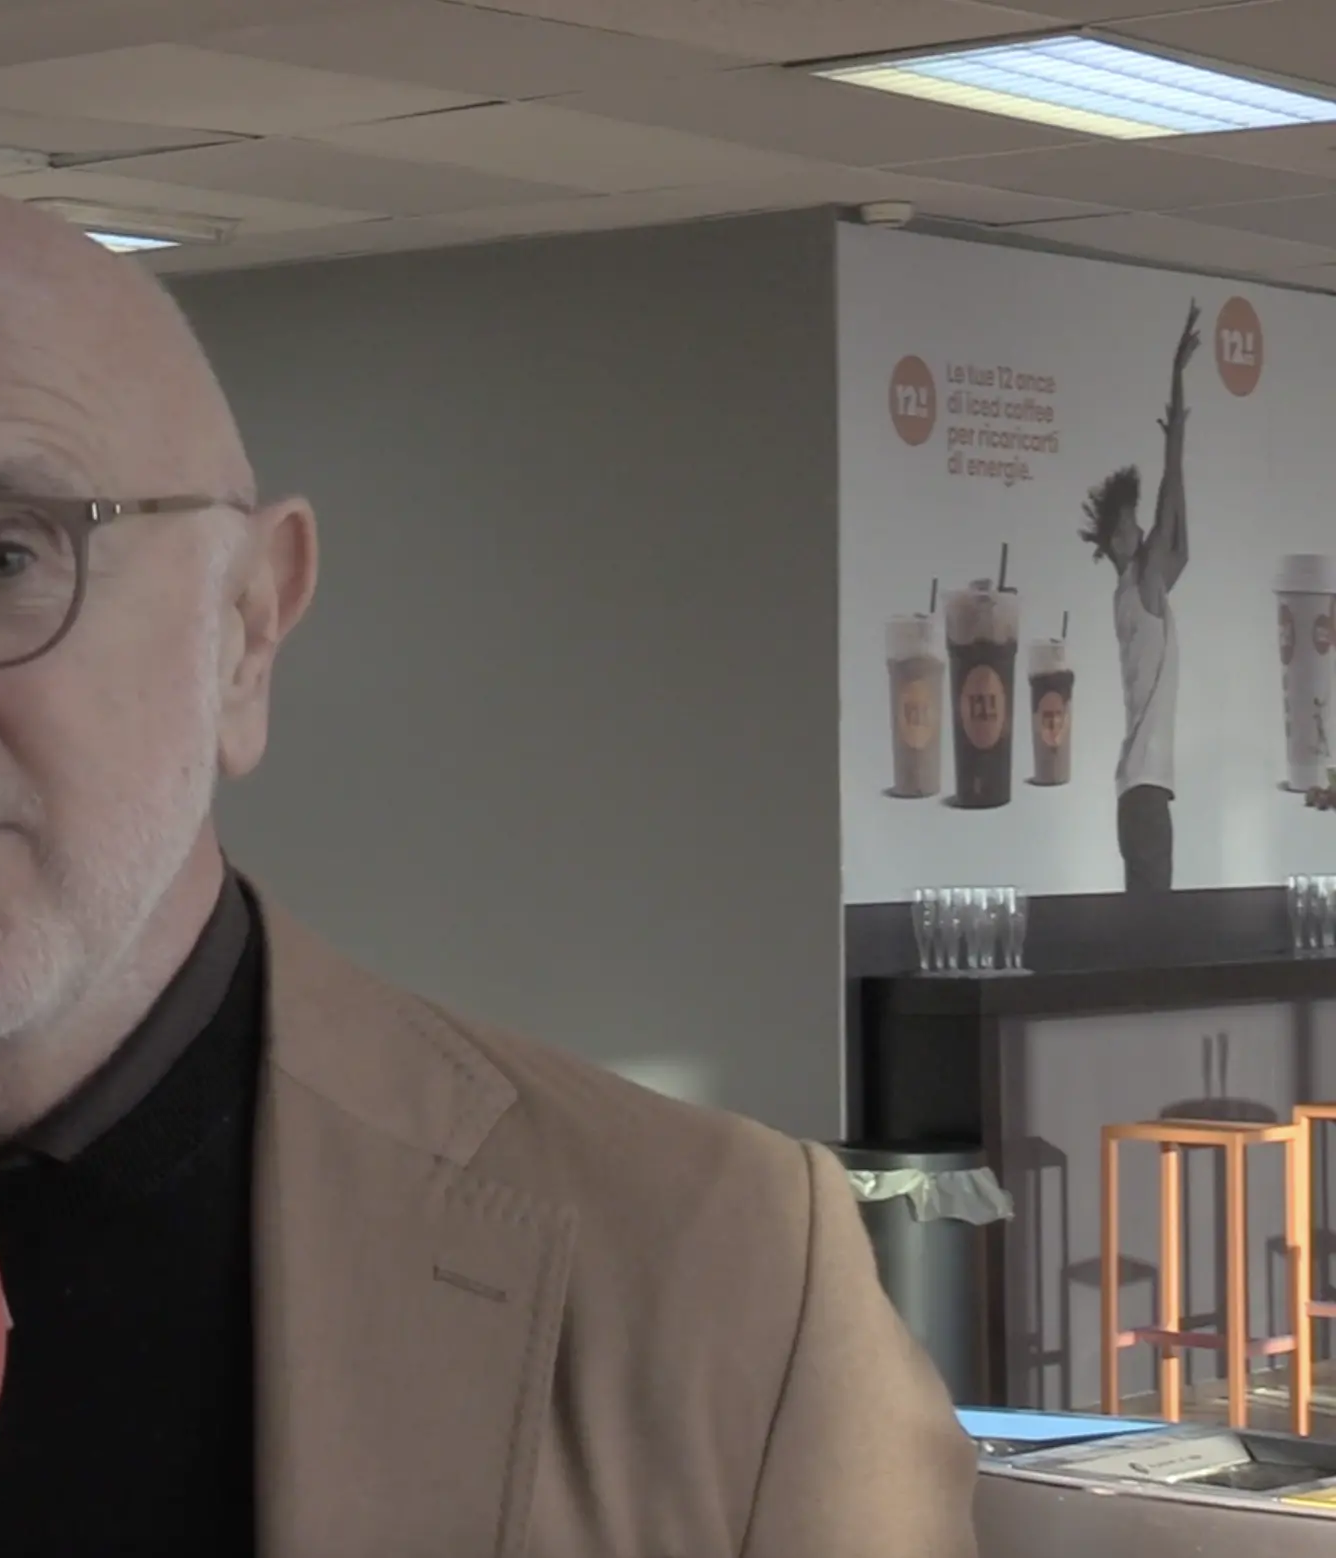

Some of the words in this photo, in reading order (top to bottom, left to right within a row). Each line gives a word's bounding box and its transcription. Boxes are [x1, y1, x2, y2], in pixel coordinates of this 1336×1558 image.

[947, 361, 965, 383] Le
[968, 365, 994, 386] tue
[997, 366, 1013, 389] 12
[947, 391, 963, 414] di
[966, 391, 1001, 417] iced
[1004, 398, 1054, 423] coffee
[947, 426, 975, 452] per
[978, 423, 1059, 453] ricaricarti
[947, 451, 963, 475] di
